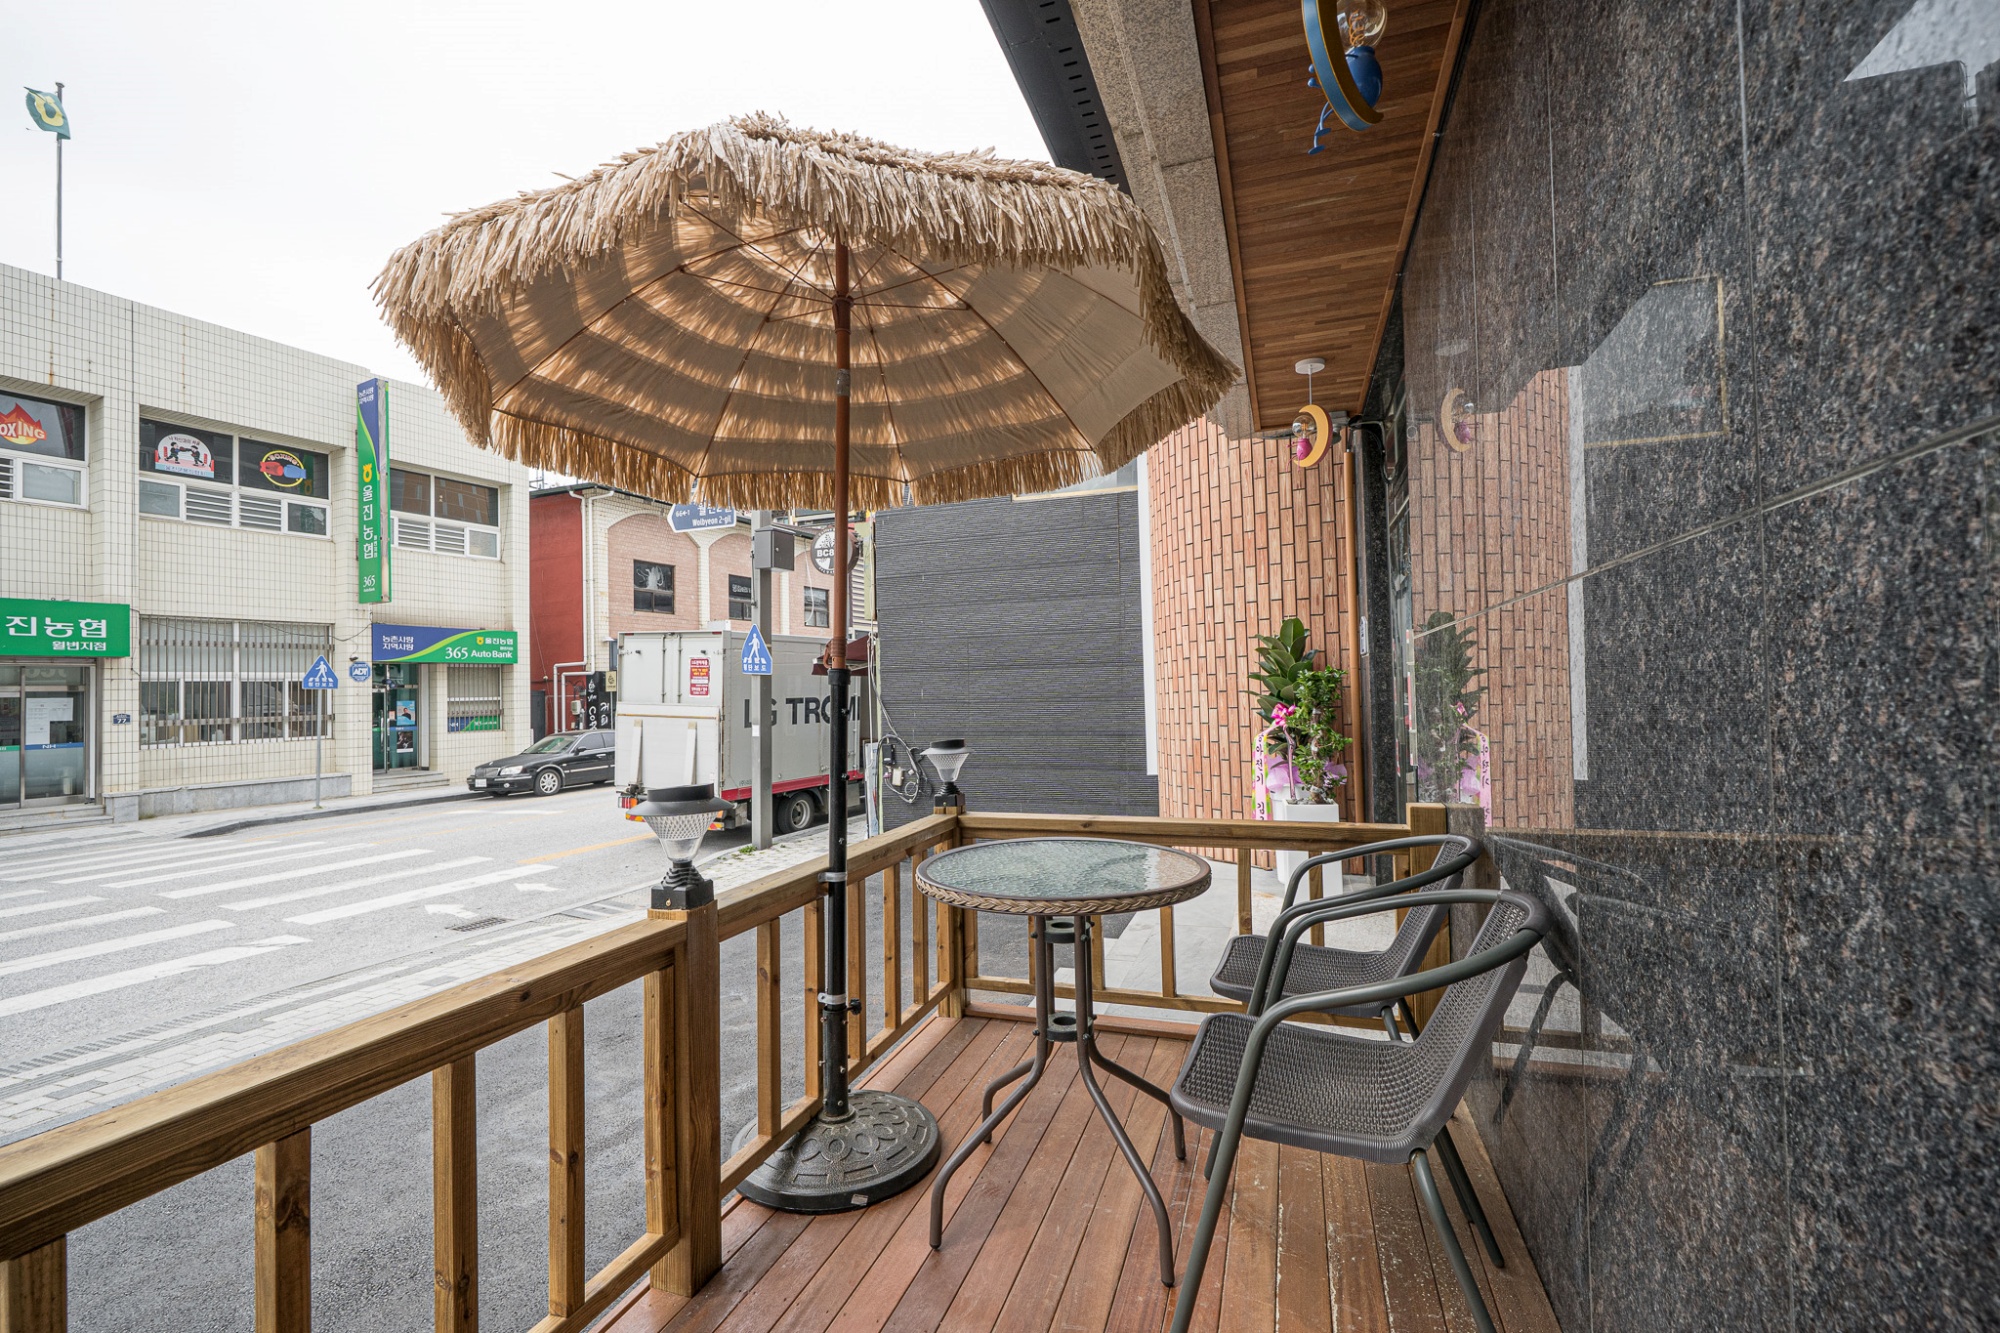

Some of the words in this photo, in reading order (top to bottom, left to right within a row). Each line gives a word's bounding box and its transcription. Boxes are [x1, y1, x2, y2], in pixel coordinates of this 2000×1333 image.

[363, 484, 374, 559] 울진농협
[692, 517, 718, 527] Wolbyeon
[816, 548, 835, 558] BC8
[363, 575, 376, 588] 365
[5, 615, 107, 639] 진농협
[382, 635, 414, 643] 농촌사랑
[52, 641, 107, 651] 월변지점
[445, 647, 468, 660] 365
[471, 650, 491, 658] Auto
[492, 650, 513, 659] Bank
[352, 667, 368, 676] ADT
[743, 663, 767, 671] 횡단보도
